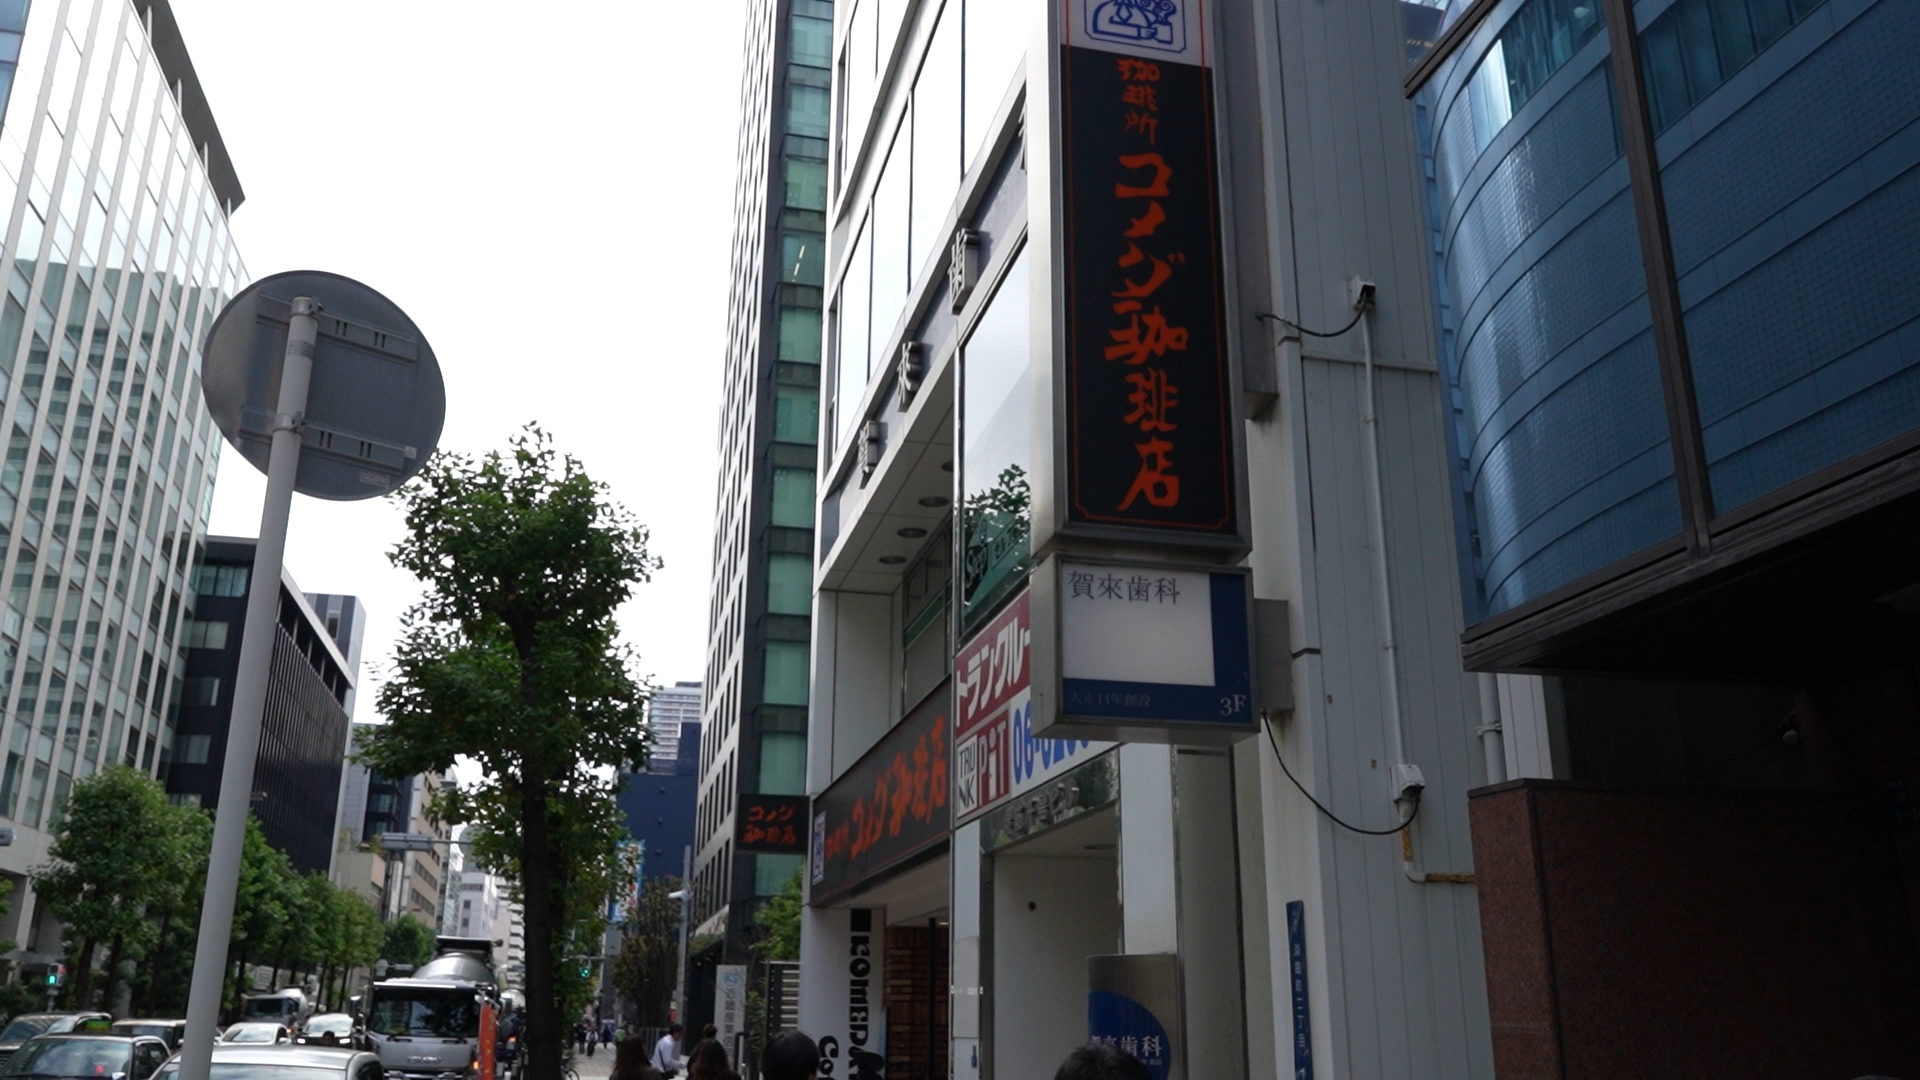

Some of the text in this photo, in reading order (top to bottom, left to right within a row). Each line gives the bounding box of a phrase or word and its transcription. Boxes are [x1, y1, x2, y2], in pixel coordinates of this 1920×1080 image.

[1103, 152, 1188, 511] コメダ珈琲店
[1068, 570, 1180, 604] 賀來歯科
[1220, 693, 1247, 716] 3F
[959, 739, 975, 779] TRU
[959, 776, 975, 809] NK
[747, 804, 797, 822] コメダ
[817, 1035, 839, 1080] Co
